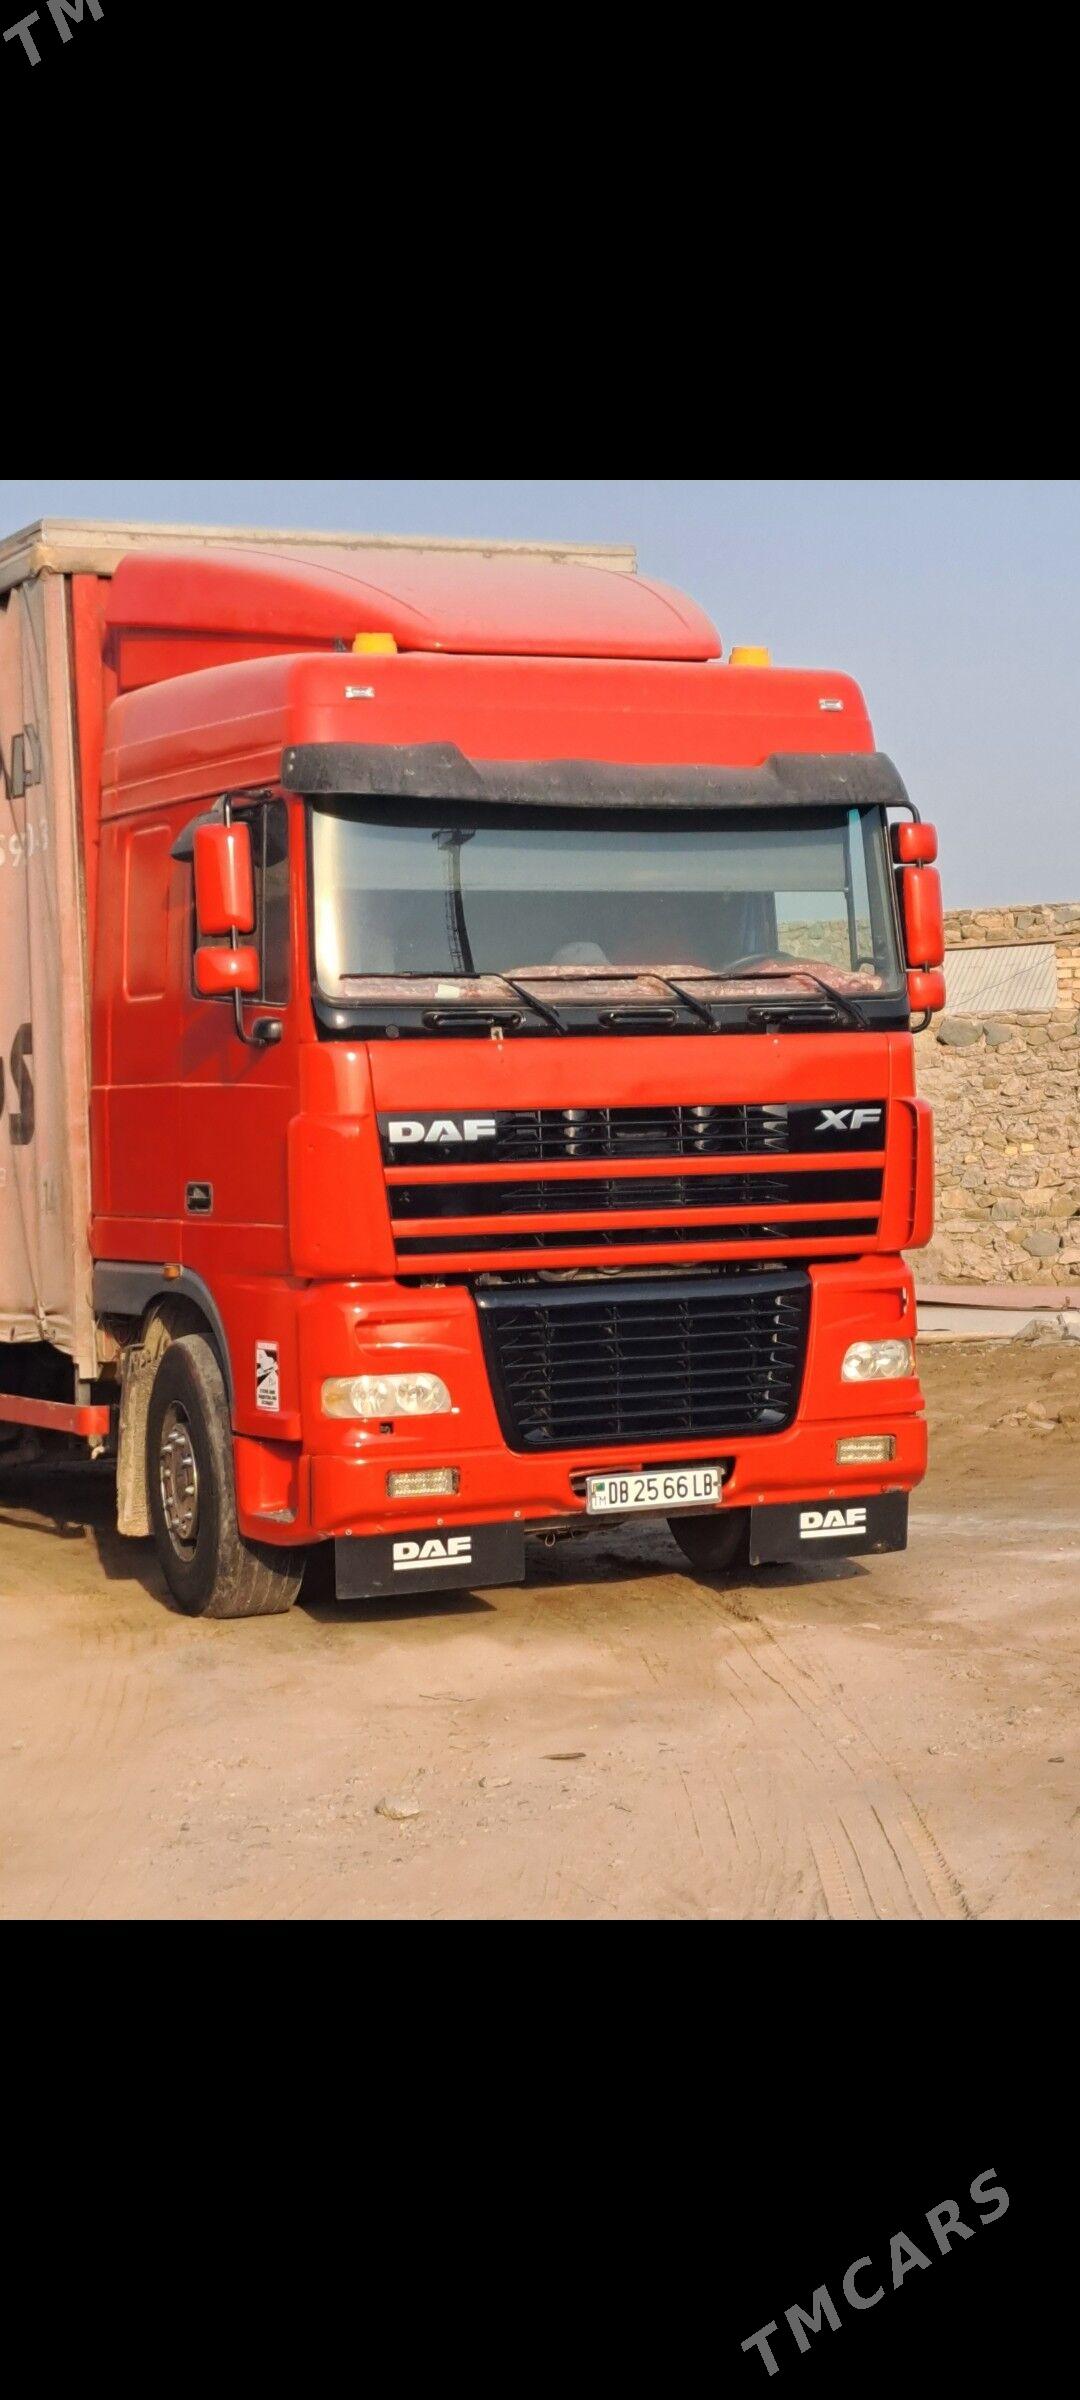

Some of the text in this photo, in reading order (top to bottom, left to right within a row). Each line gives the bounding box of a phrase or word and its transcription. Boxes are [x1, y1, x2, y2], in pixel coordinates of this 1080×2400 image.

[388, 1119, 496, 1143] DAF
[814, 1109, 882, 1131] XF
[609, 1473, 713, 1504] DB 25 66 LB
[800, 1508, 867, 1529] DAF
[393, 1536, 471, 1561] DAF
